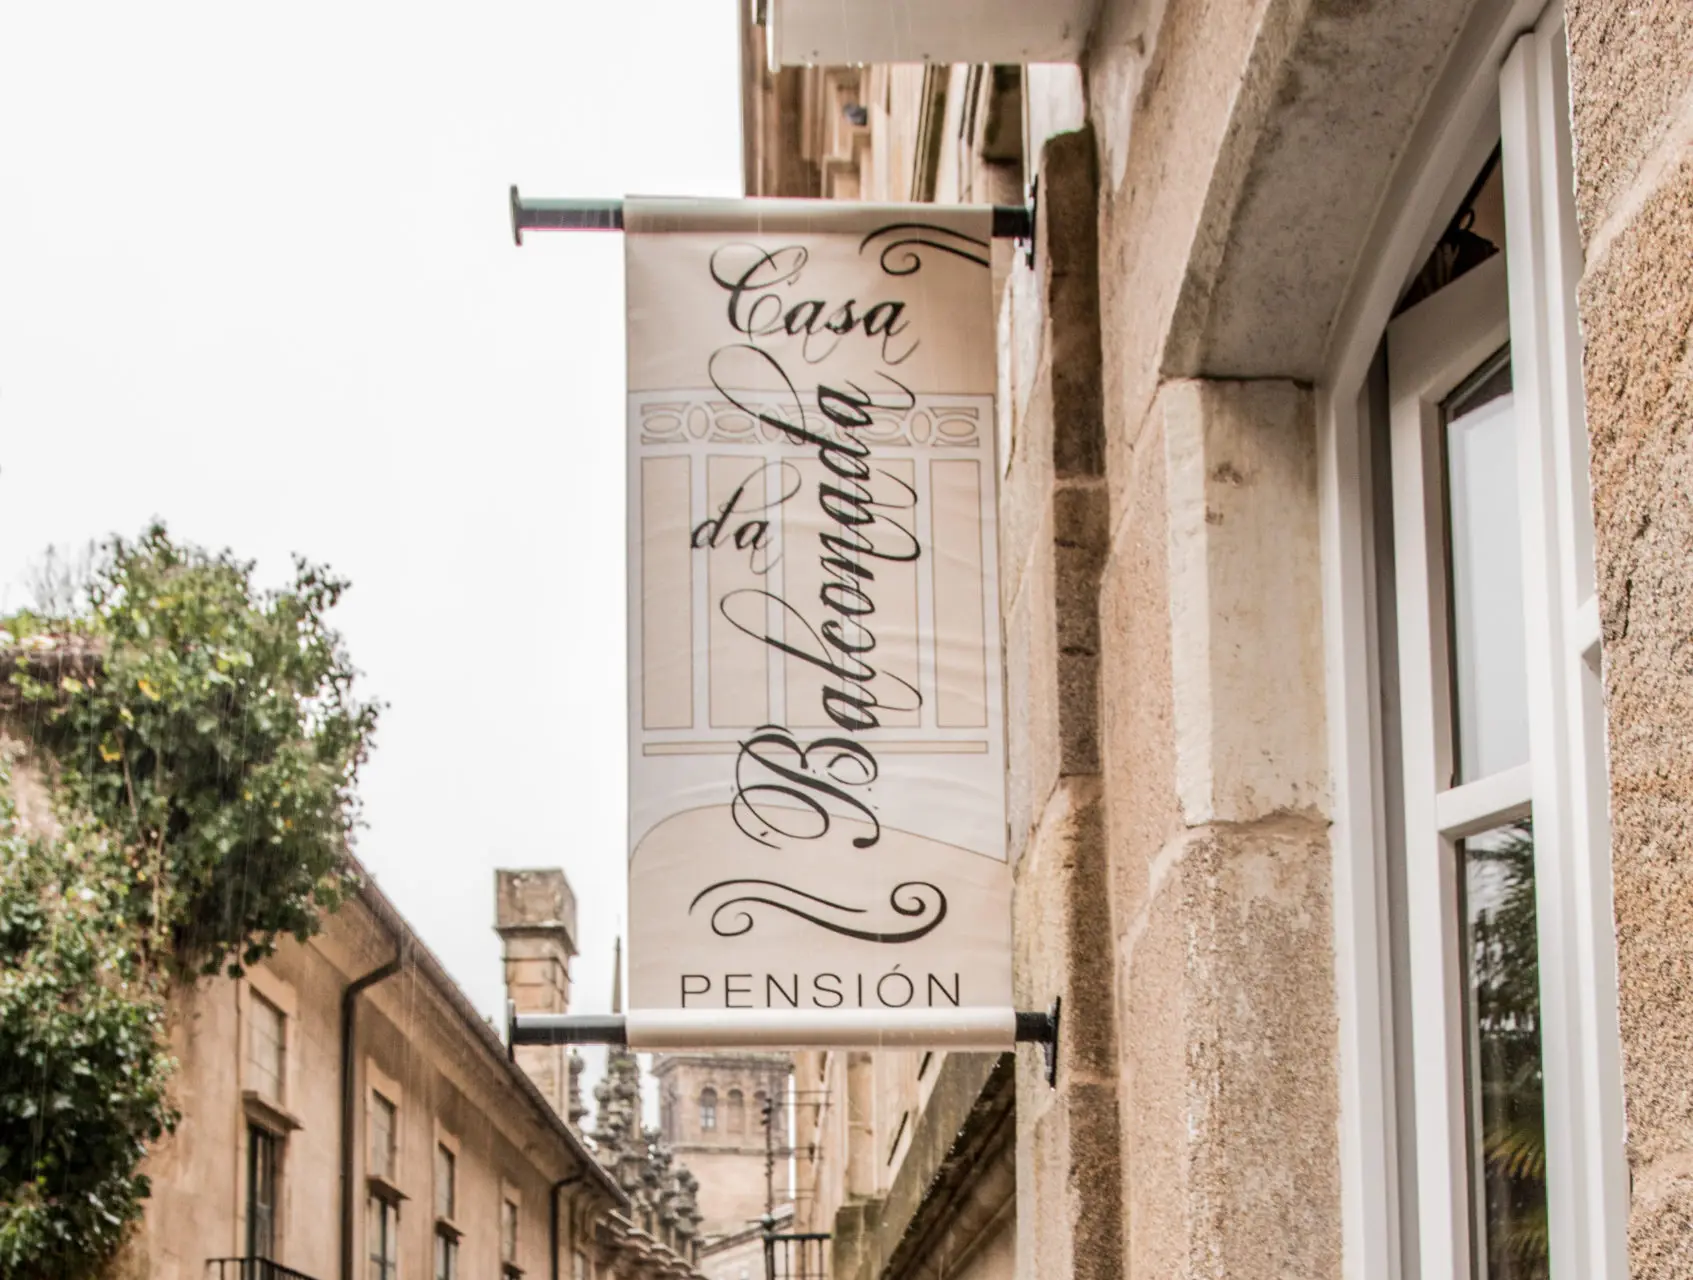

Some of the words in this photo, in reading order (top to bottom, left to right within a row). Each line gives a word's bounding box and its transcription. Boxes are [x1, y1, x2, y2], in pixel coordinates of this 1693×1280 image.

[709, 244, 920, 363] Casa
[690, 463, 802, 574] da
[709, 344, 921, 849] Balconada
[681, 964, 962, 1009] PENSIÓN
